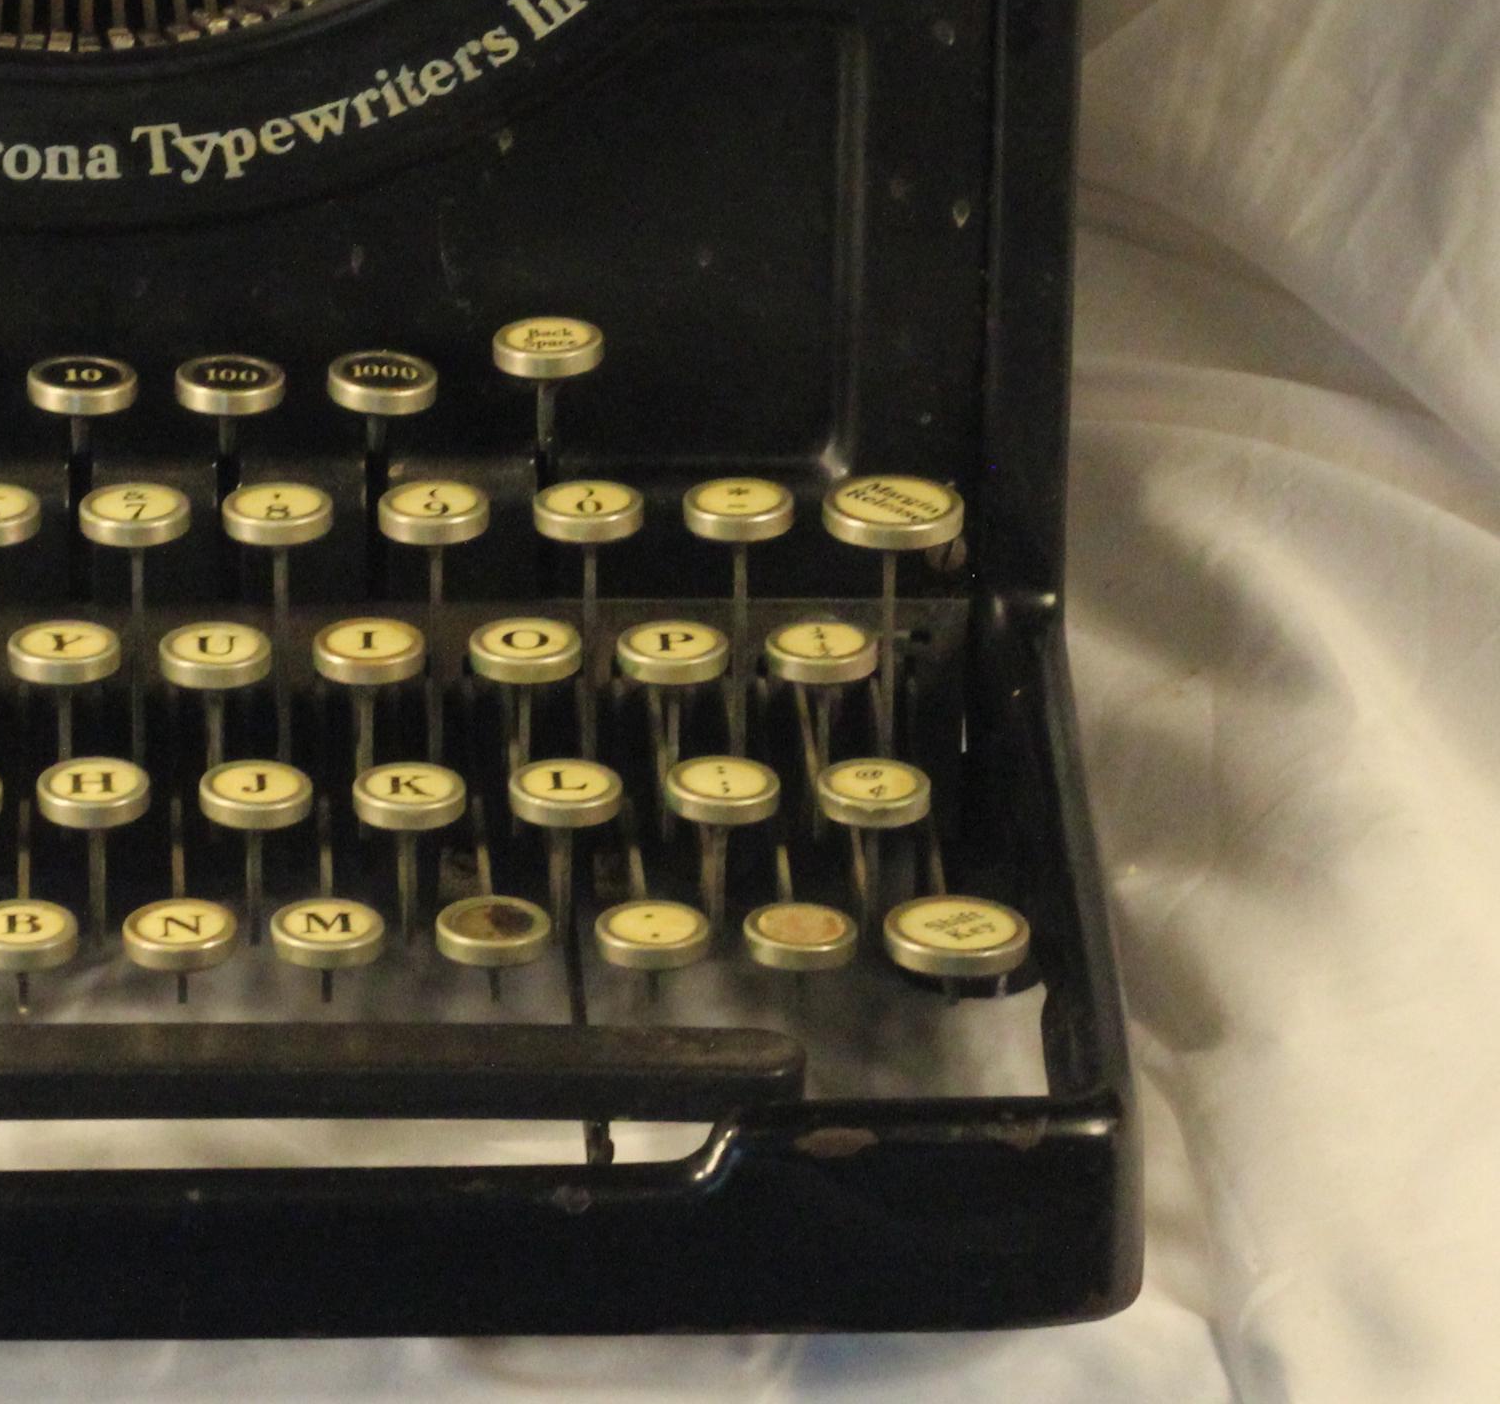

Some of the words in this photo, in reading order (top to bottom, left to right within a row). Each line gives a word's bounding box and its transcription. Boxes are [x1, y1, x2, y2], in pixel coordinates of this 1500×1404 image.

[131, 24, 521, 184] Typewriters
[528, 327, 573, 338] Back
[523, 337, 577, 349] Space
[64, 369, 102, 383] 10
[205, 368, 260, 383] 100
[350, 365, 419, 381] 1000
[845, 488, 926, 525] Release
[864, 481, 940, 515] Margin
[124, 504, 147, 520] 7
[265, 503, 291, 520] 8
[423, 501, 450, 516] 9
[51, 634, 87, 652] Y
[197, 635, 235, 656] U
[358, 631, 375, 652] I
[501, 629, 549, 650] O
[655, 632, 694, 652] P
[68, 771, 115, 794] H
[241, 772, 268, 793] J
[387, 775, 430, 796] K
[549, 770, 588, 792] L
[1, 914, 42, 934] B
[158, 915, 201, 937] N
[303, 912, 352, 933] M
[943, 922, 996, 941] Key
